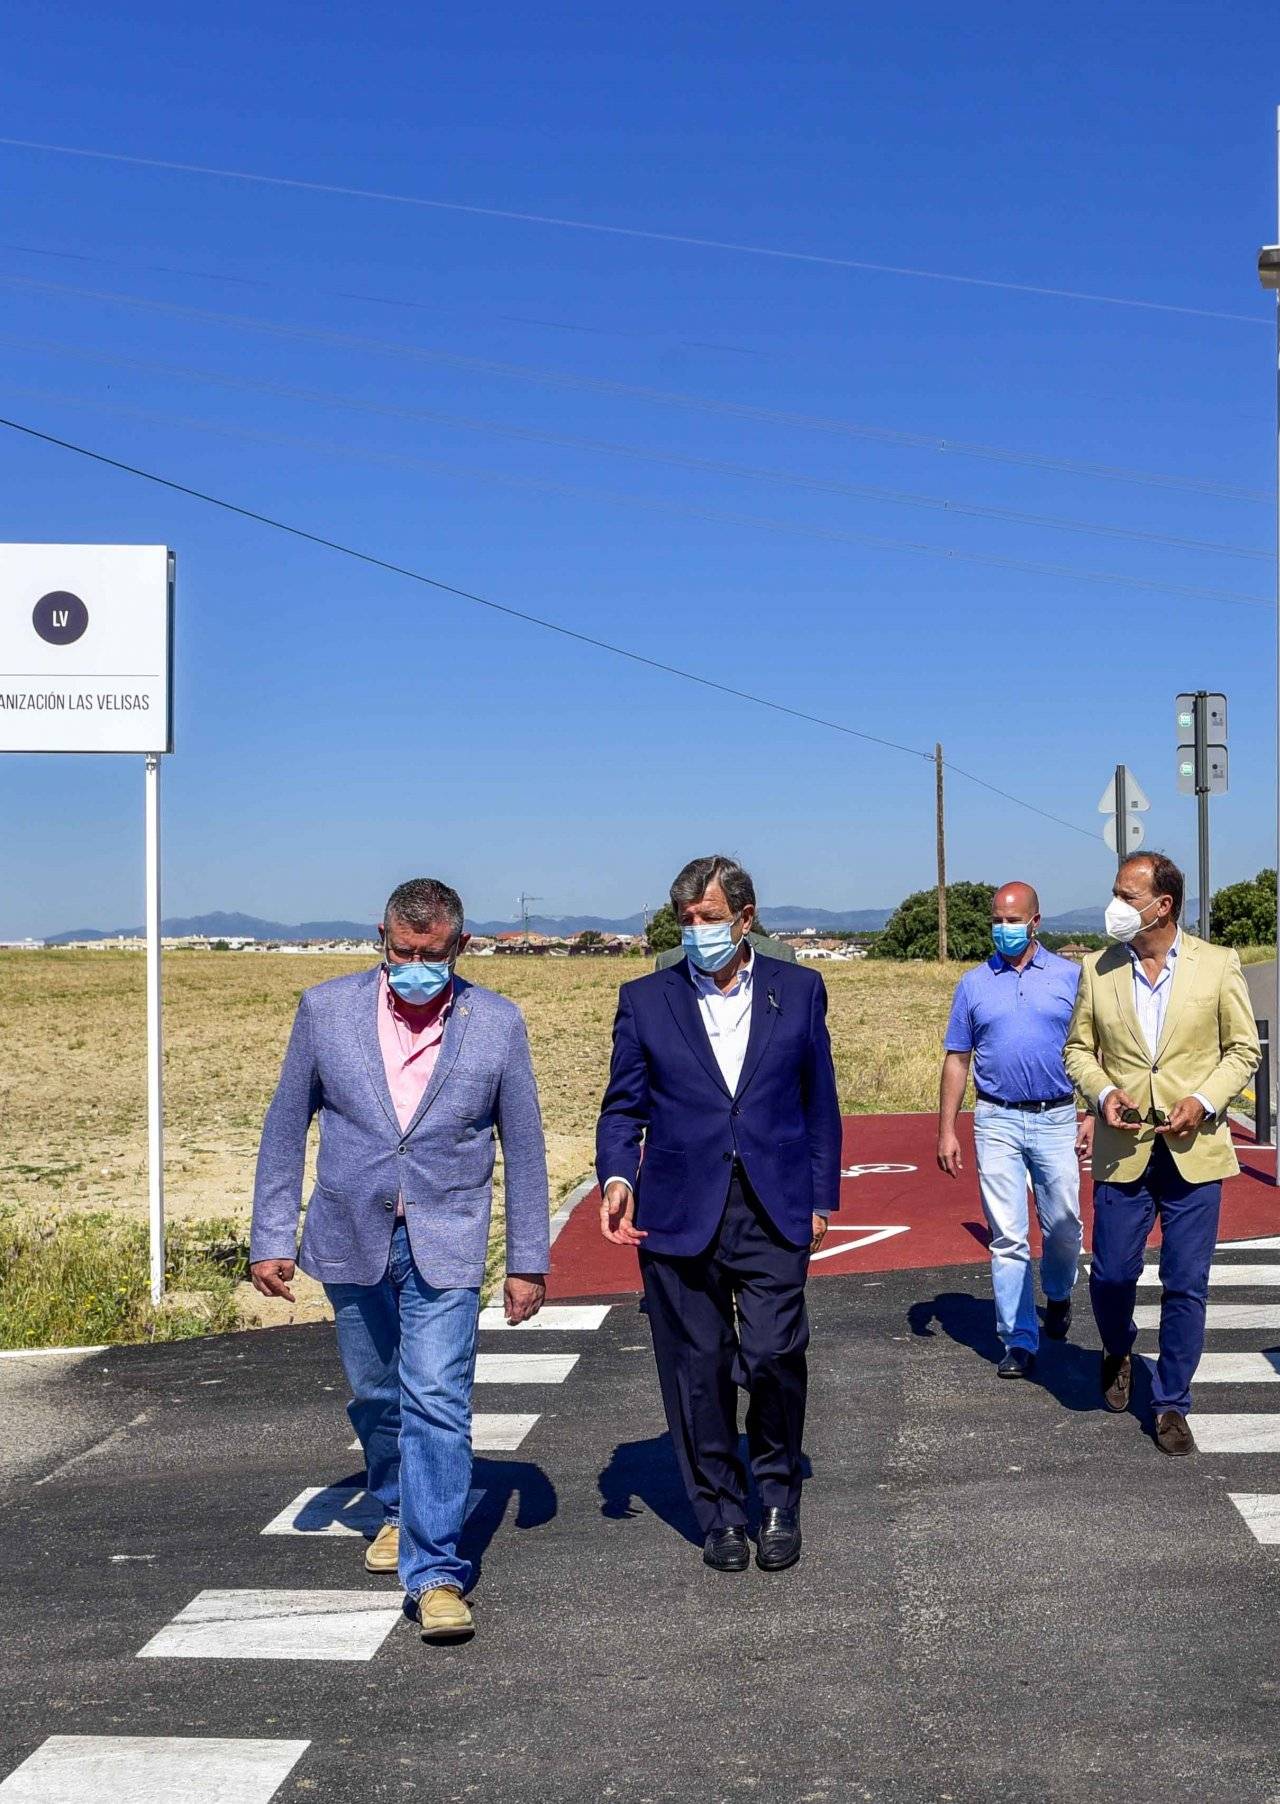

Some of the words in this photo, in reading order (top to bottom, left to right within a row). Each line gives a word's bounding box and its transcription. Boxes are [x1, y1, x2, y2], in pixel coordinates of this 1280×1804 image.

[52, 610, 69, 627] LV
[69, 694, 93, 710] LAS
[97, 694, 150, 711] VELISAS
